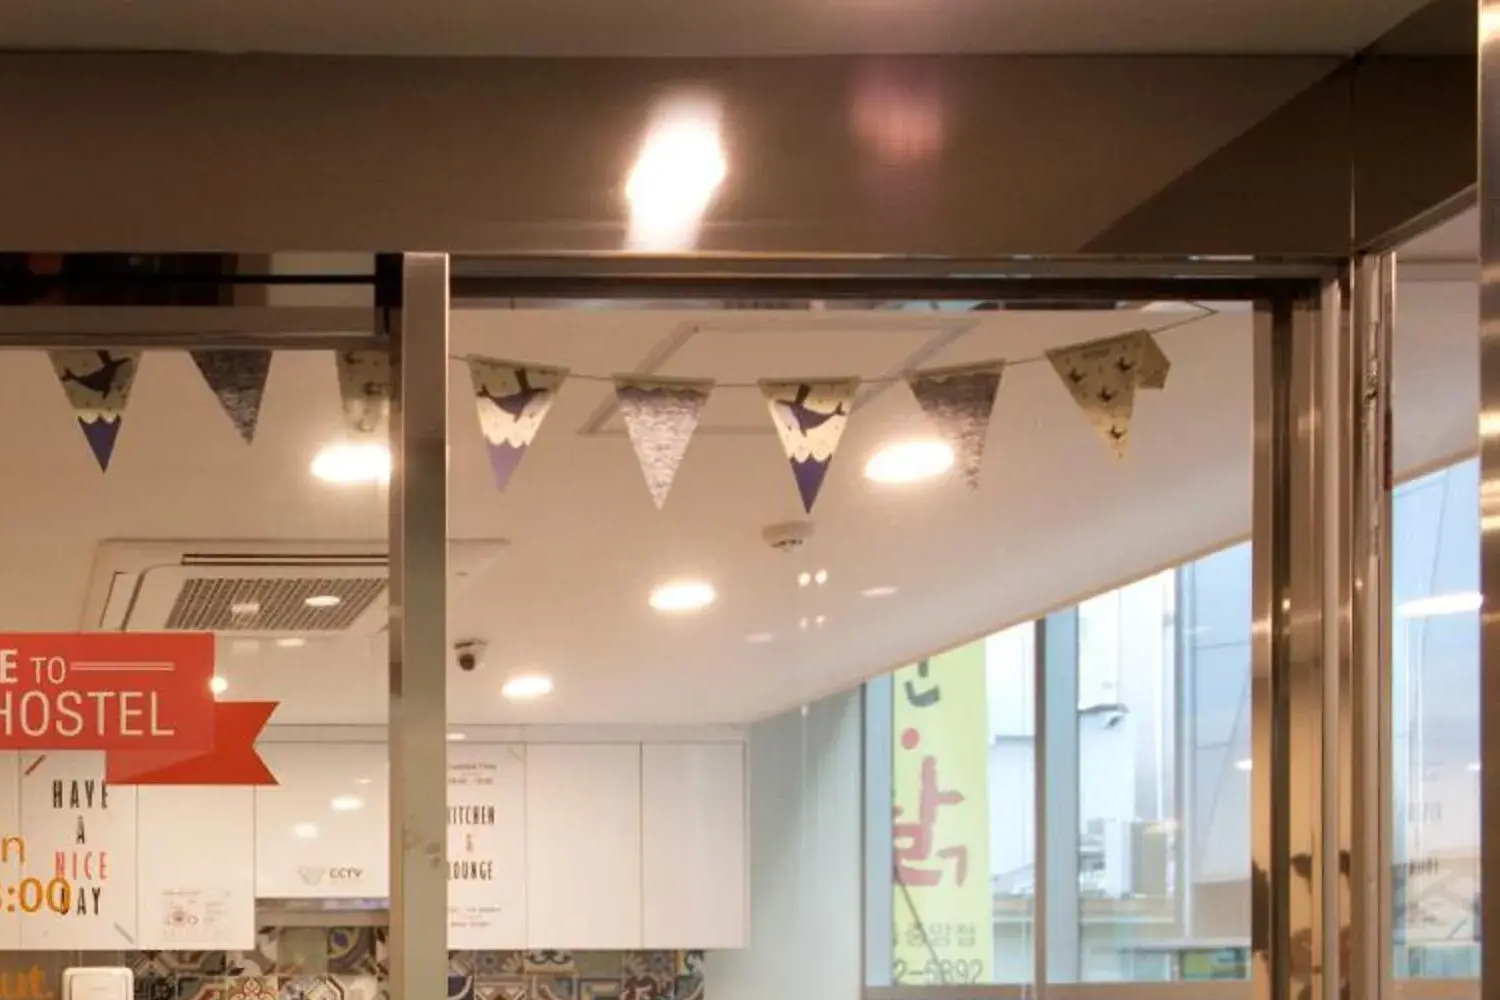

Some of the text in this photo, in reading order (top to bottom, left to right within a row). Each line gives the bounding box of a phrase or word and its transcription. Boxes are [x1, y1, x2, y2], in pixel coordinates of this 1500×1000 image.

[29, 656, 67, 684] TO
[52, 779, 108, 809] HAVE
[76, 815, 86, 844] A
[55, 851, 107, 880] NICE
